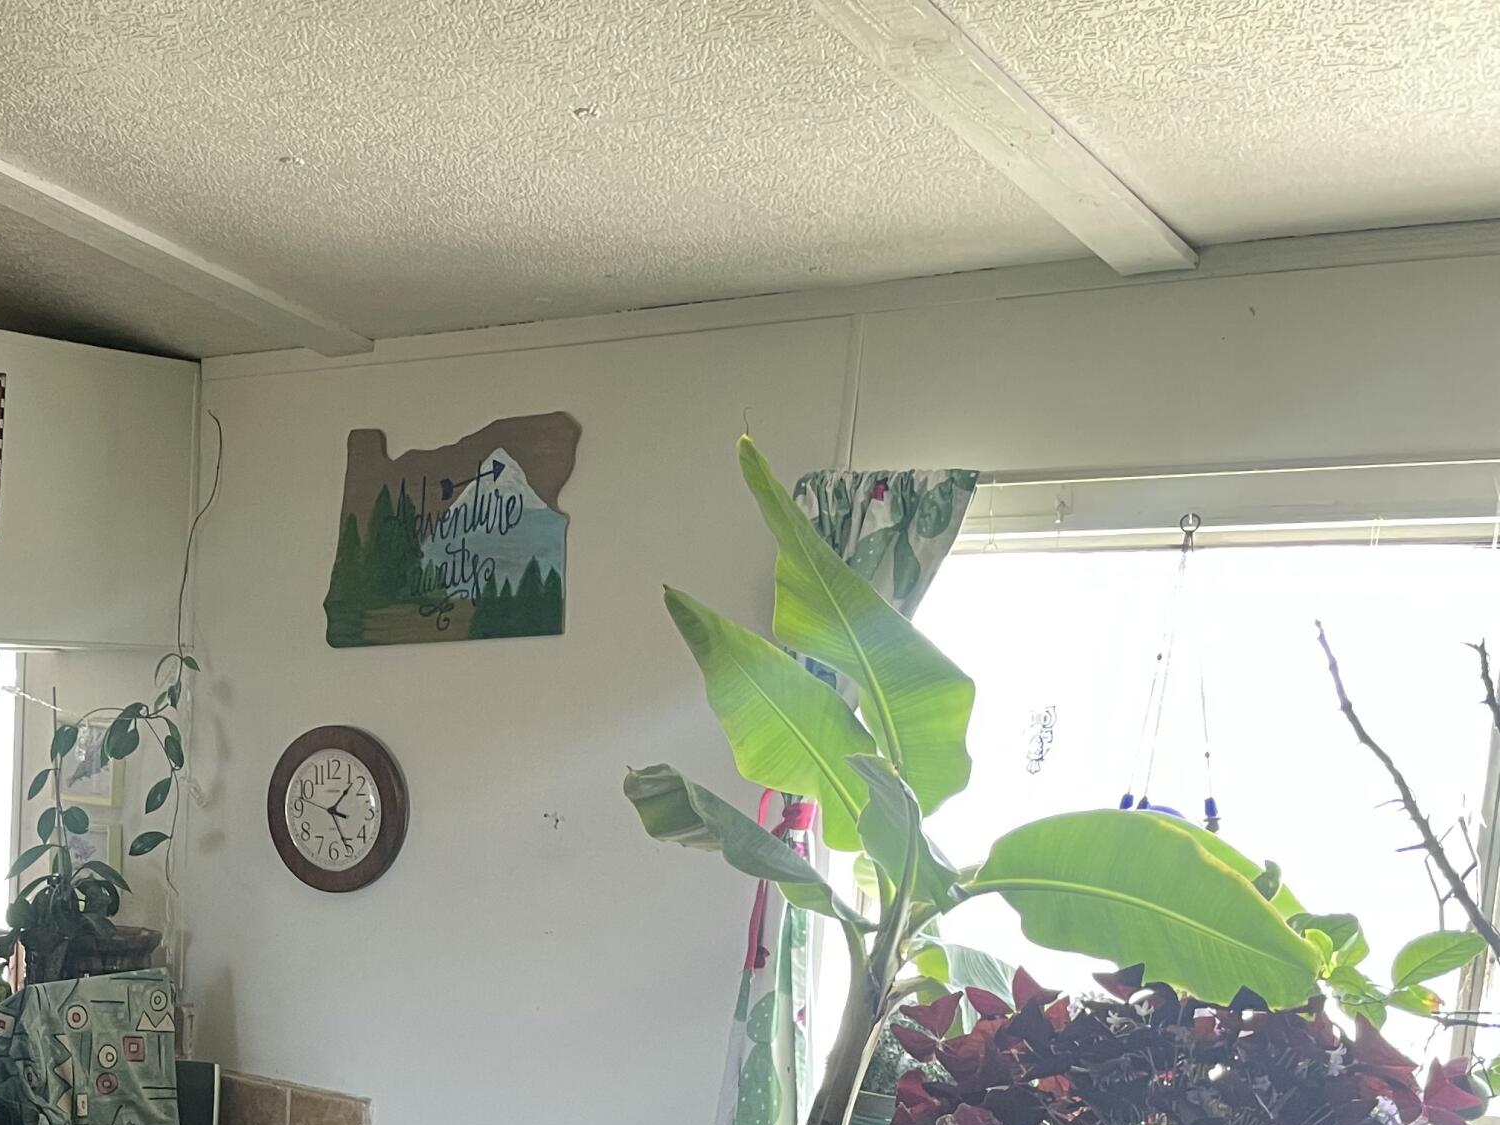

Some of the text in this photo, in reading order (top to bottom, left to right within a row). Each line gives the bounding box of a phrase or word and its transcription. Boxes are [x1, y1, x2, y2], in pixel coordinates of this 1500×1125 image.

[315, 765, 324, 785] 11
[327, 759, 342, 780] 12
[347, 764, 351, 784] 1
[300, 779, 314, 800] 10
[356, 776, 366, 796] 2
[294, 799, 304, 819] 9
[301, 821, 311, 841] 8
[357, 824, 366, 844] 4
[315, 835, 324, 855] 7
[328, 841, 339, 861] 6
[343, 838, 354, 858] 5
